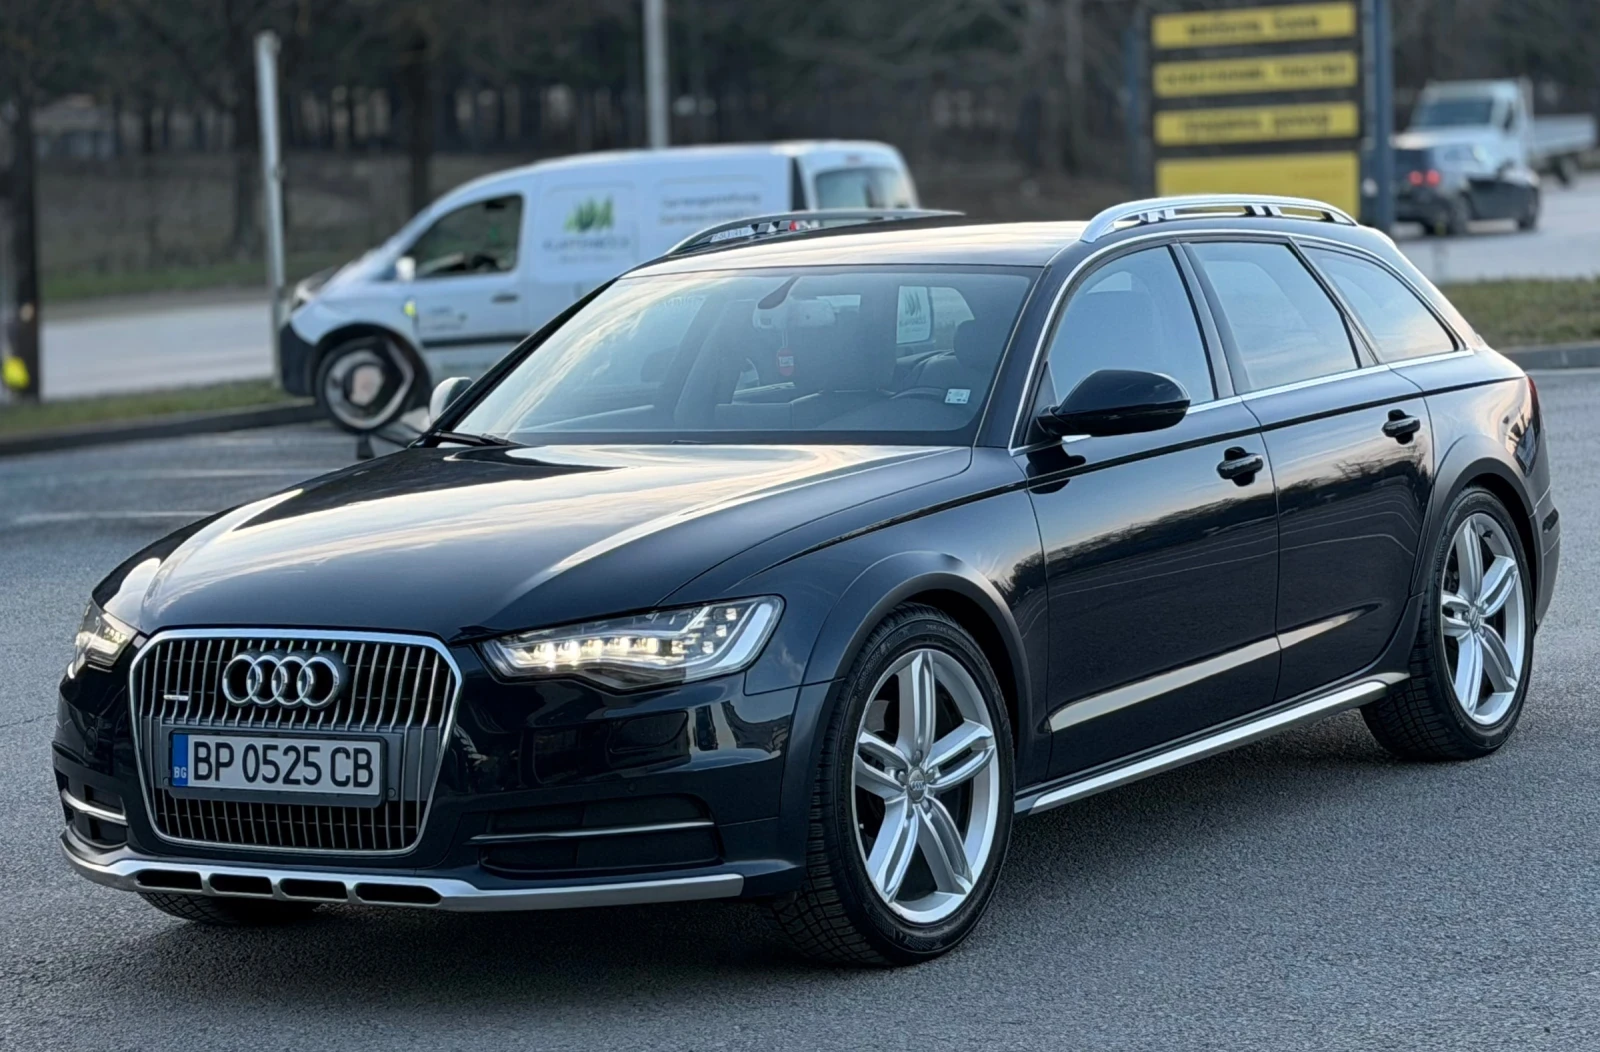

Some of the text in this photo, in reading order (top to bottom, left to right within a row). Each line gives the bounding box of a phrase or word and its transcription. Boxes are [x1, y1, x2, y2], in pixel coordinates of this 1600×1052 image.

[173, 766, 187, 778] BG
[193, 741, 373, 788] BP 0525 CB
